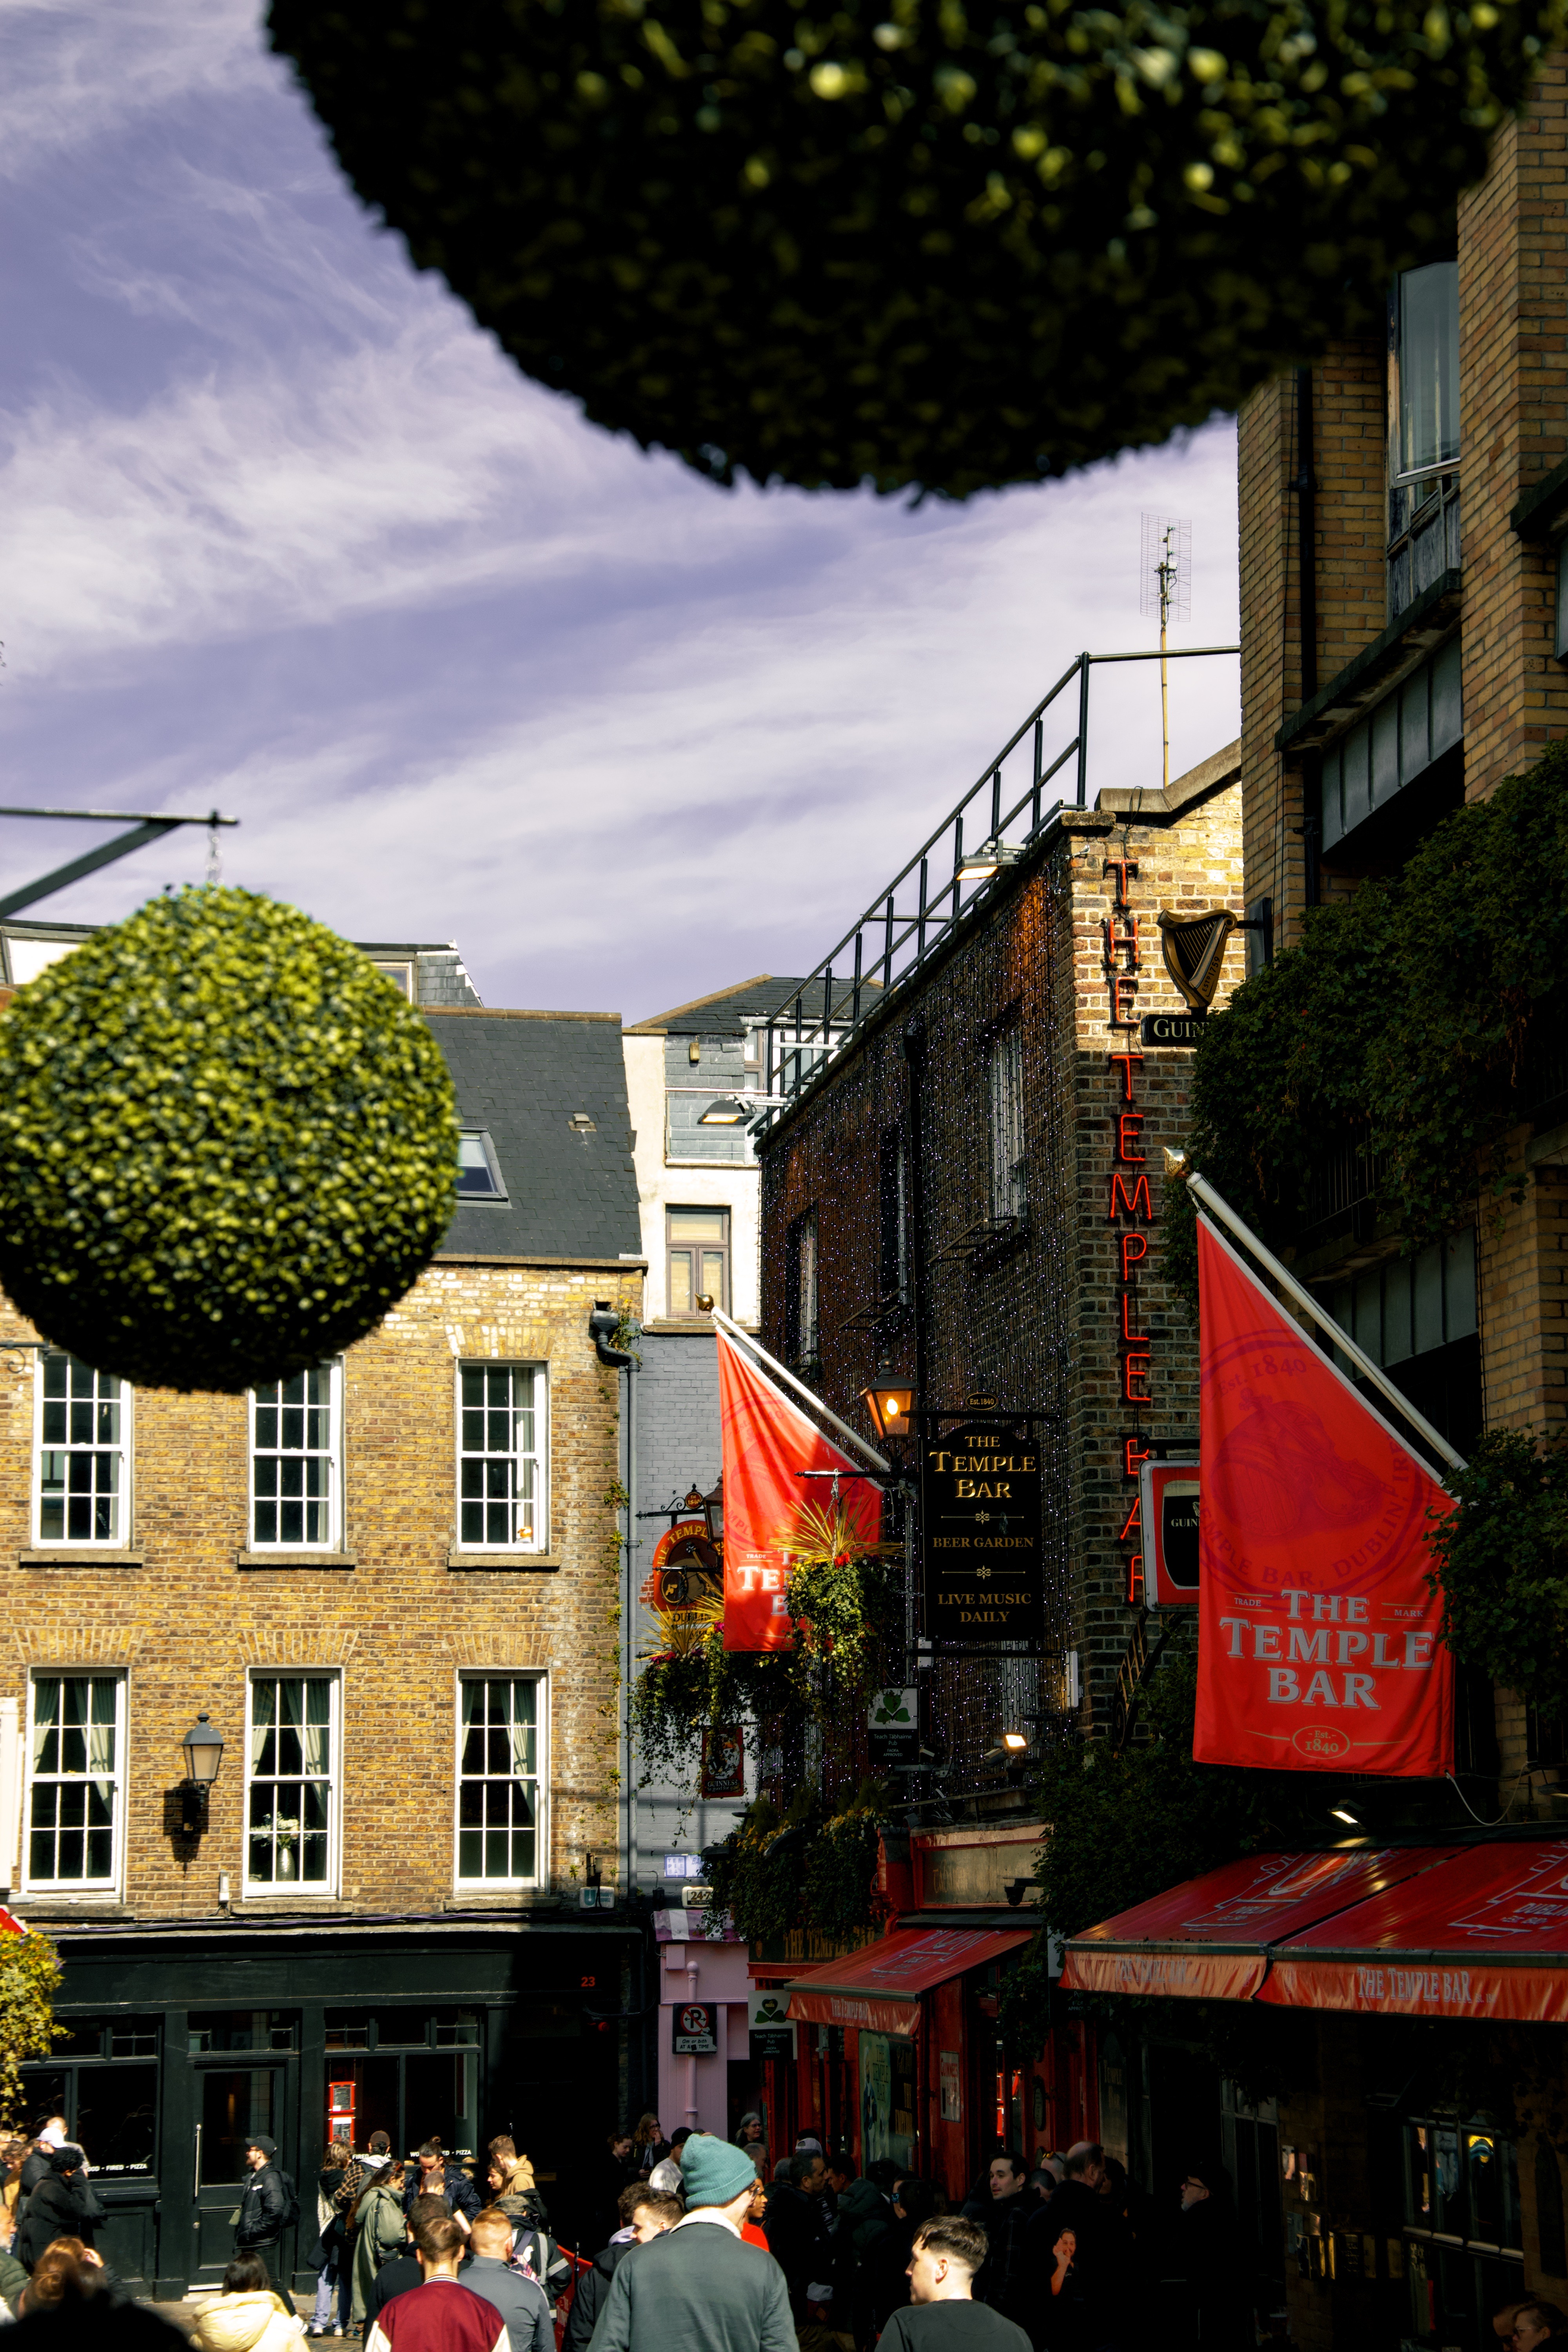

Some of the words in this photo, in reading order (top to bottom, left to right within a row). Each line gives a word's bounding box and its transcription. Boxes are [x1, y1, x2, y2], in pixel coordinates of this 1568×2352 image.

[1101, 858, 1143, 1029] THE
[1208, 956, 1220, 976] 1759
[1107, 1054, 1154, 1402] TEMPLE
[1252, 1354, 1307, 1378] 1840
[964, 1436, 1000, 1448] THE
[929, 1451, 1036, 1472] TEMPLE
[955, 1478, 1012, 1499] BAR
[667, 1524, 708, 1544] TEMPL
[932, 1537, 971, 1548] BEER
[973, 1537, 1034, 1548] GARDEN
[938, 1593, 976, 1605] LIVE
[978, 1593, 1032, 1605] MUSIC
[1234, 1597, 1261, 1607] TRADE
[1394, 1608, 1424, 1618] MARK
[1281, 1588, 1370, 1624] THE
[960, 1611, 1010, 1622] DAILY
[1219, 1616, 1435, 1671] TEMPLE
[1267, 1667, 1381, 1710] BAR
[1314, 1730, 1332, 1739] Est.
[1305, 1739, 1339, 1754] 1840
[581, 1976, 596, 1987] 23
[1357, 1966, 1385, 1999] THE
[1387, 1967, 1439, 2002] TEMPLE
[1443, 1970, 1472, 2004] BAR
